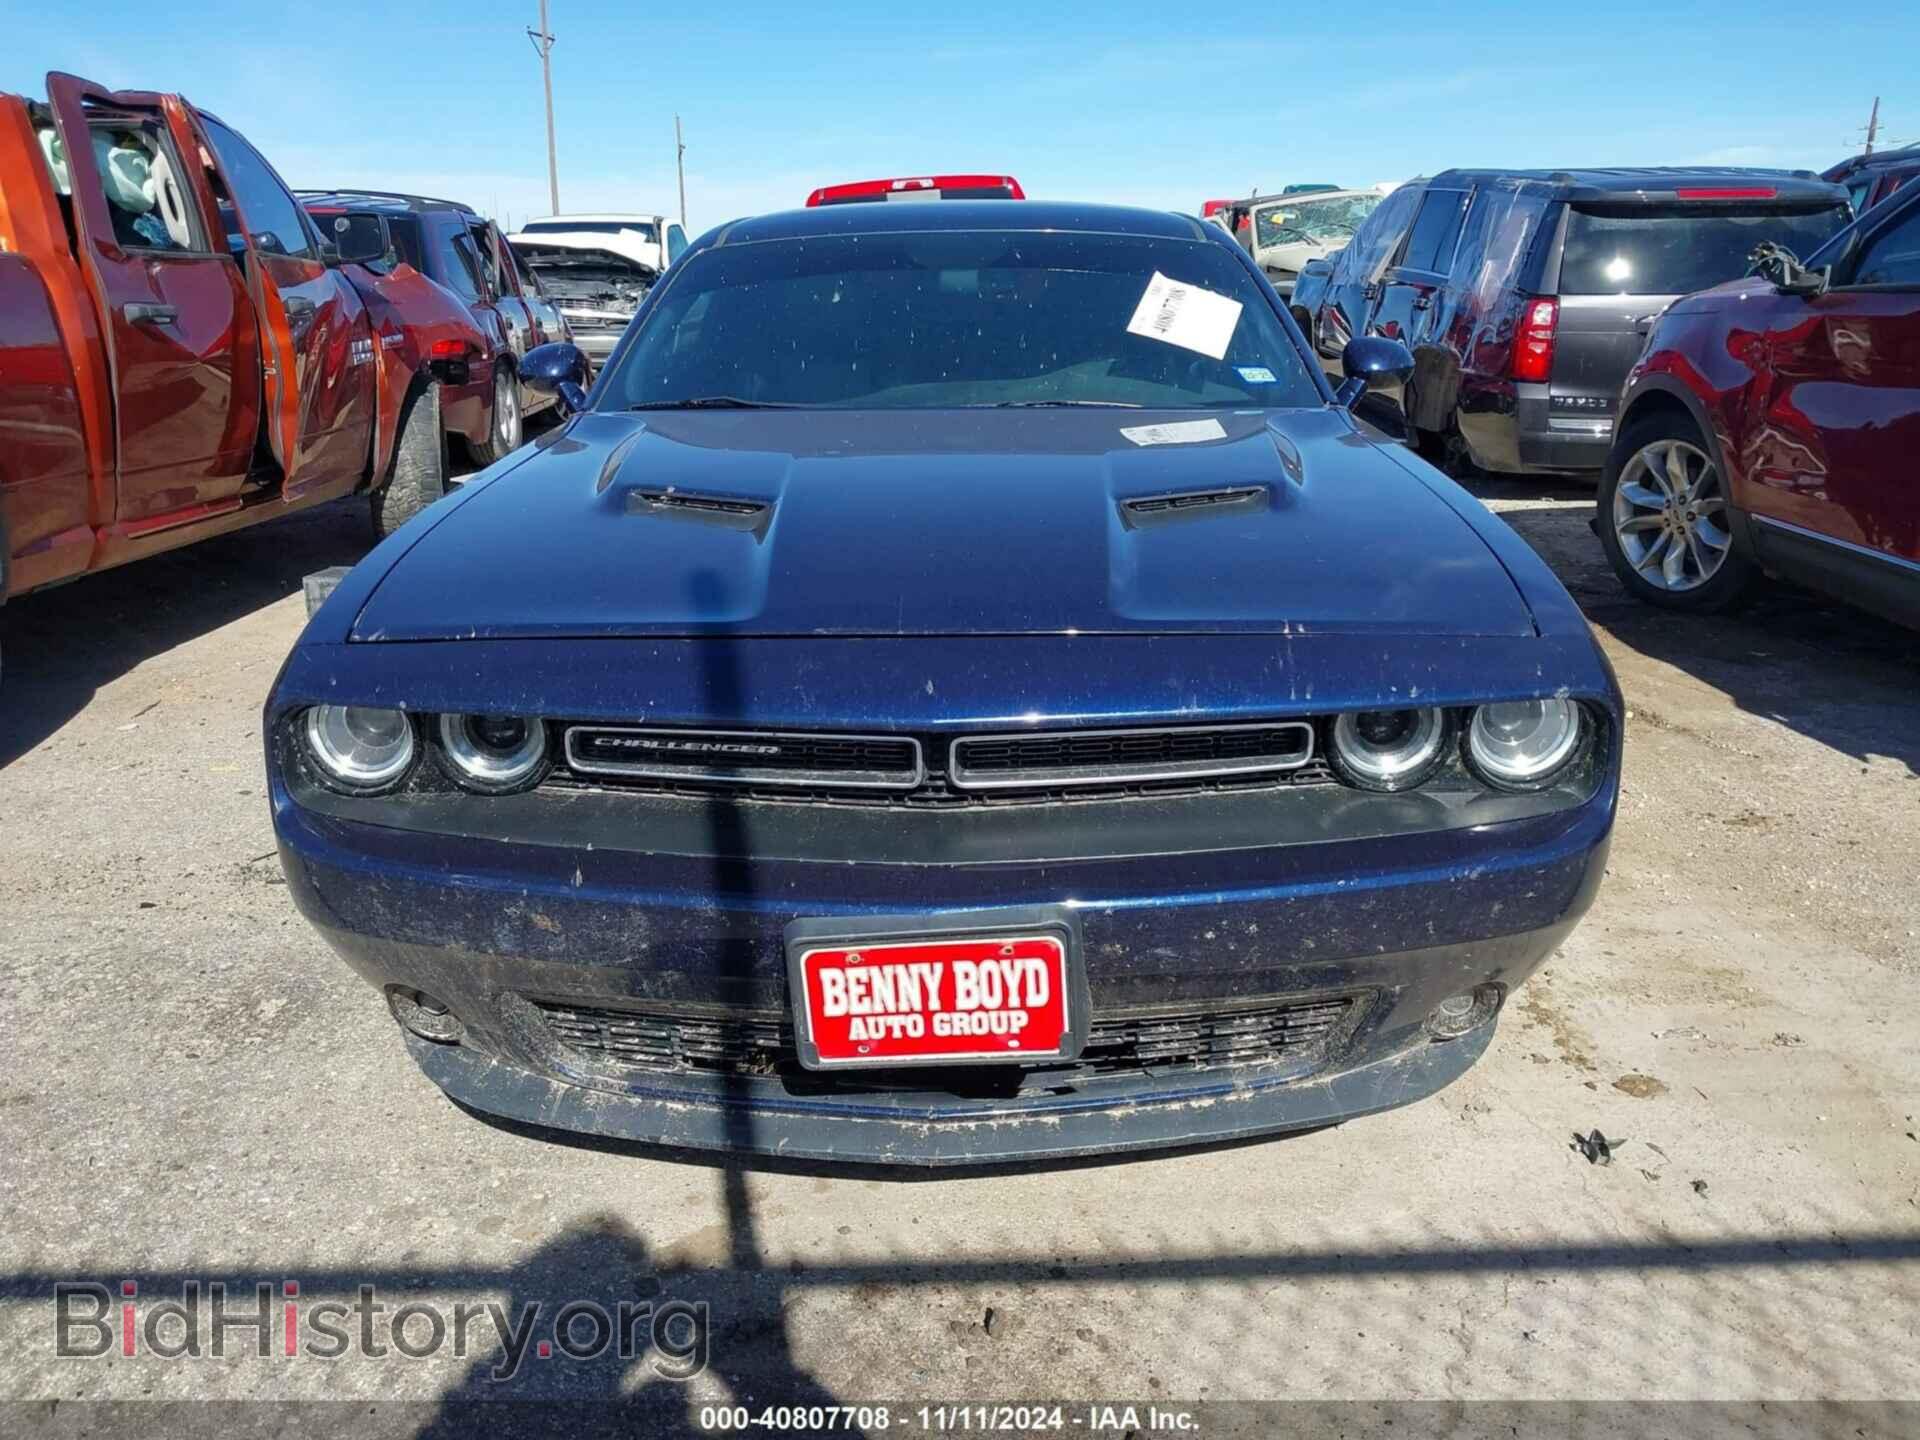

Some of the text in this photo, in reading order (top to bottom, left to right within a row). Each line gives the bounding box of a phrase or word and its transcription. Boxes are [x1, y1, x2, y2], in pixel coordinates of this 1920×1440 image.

[594, 737, 781, 754] CHALLENGER
[819, 958, 1050, 1018] BENNY BOYD
[848, 1010, 1029, 1041] AUTO GROUP
